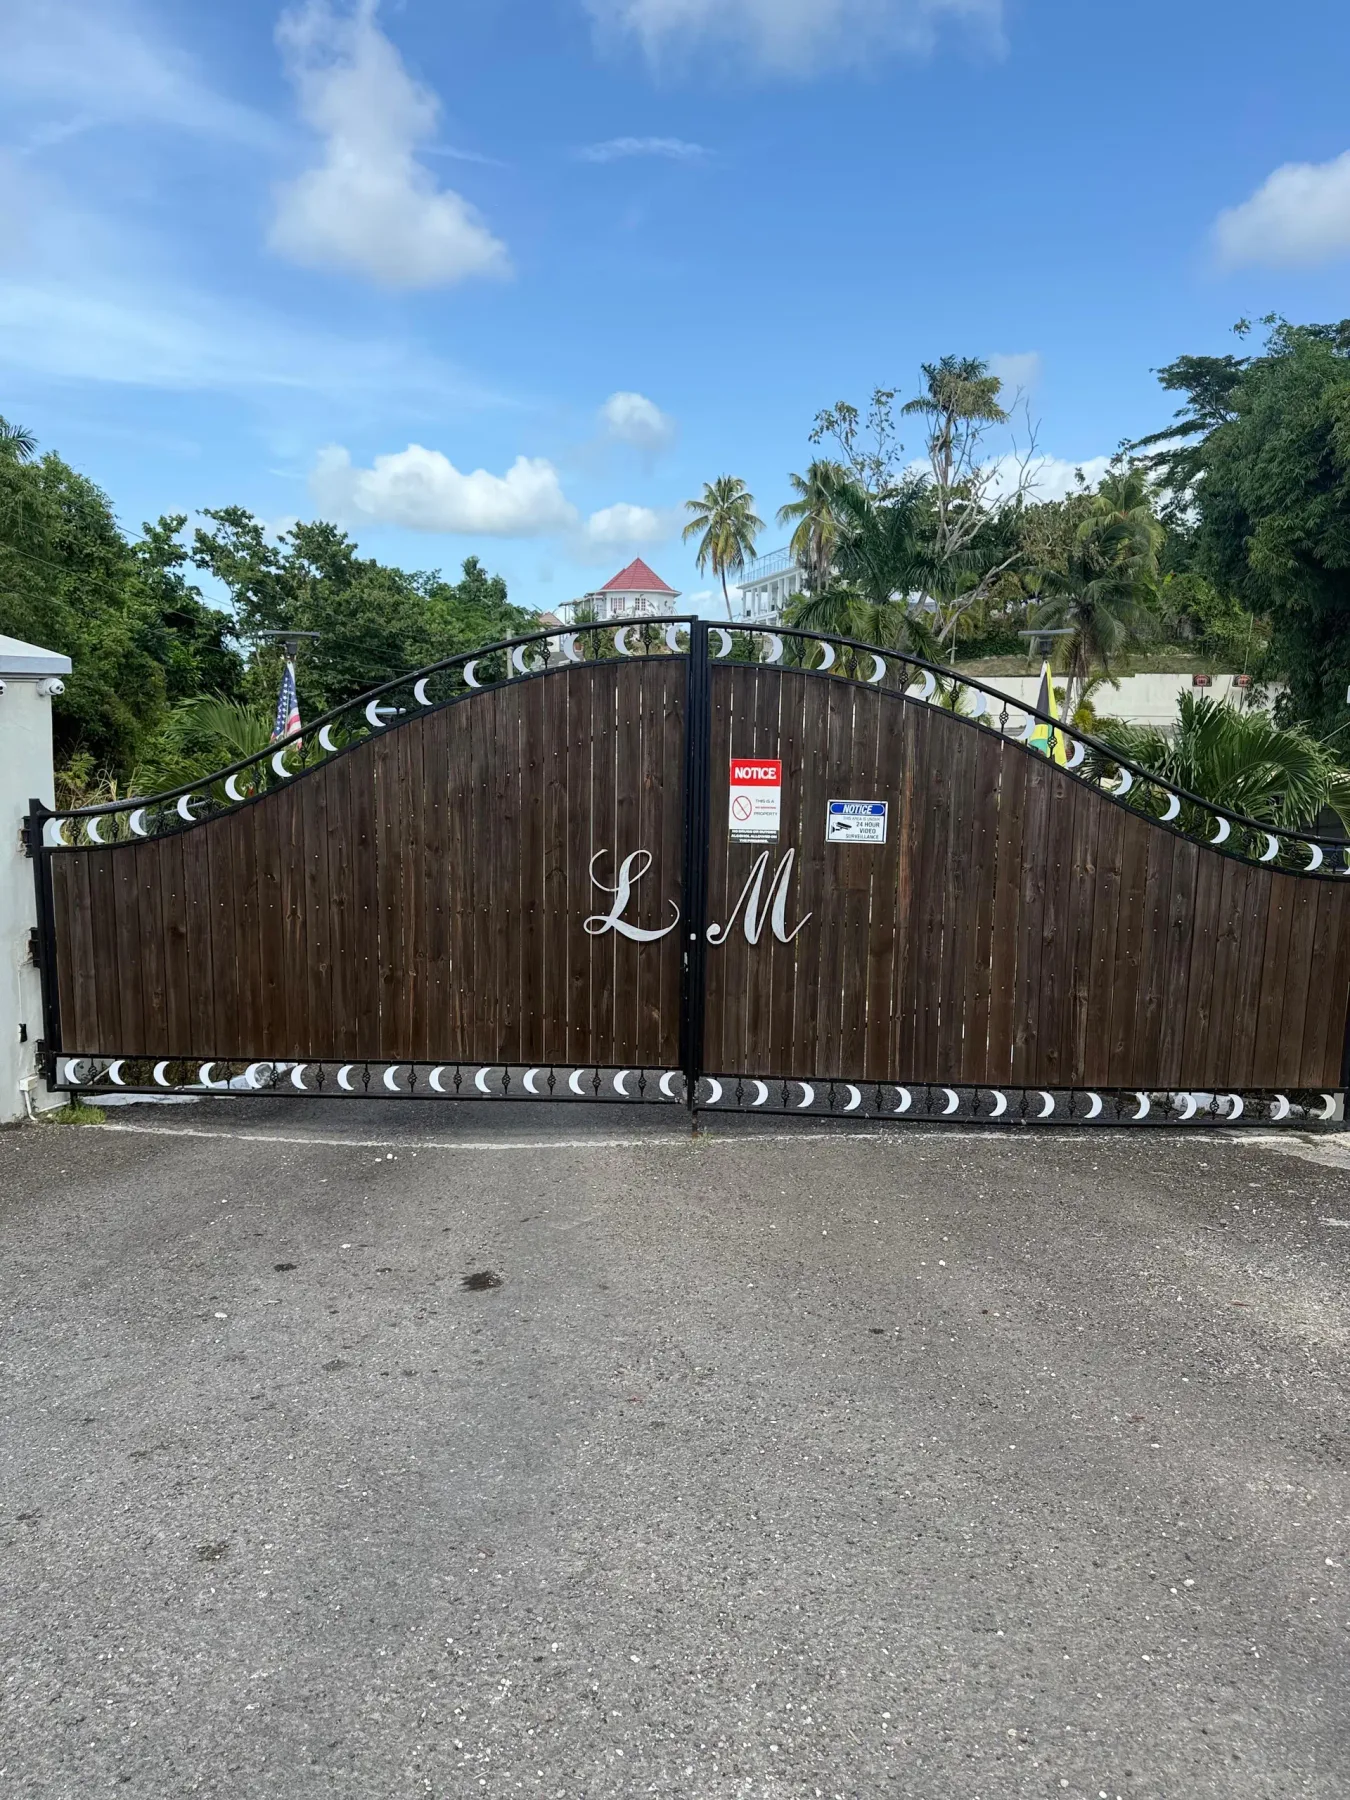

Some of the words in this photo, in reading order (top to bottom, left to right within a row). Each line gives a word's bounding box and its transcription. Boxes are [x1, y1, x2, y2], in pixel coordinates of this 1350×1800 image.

[734, 766, 777, 780] NOTICE
[842, 803, 873, 814] NOTICE
[583, 849, 680, 942] L
[706, 848, 813, 945] M
